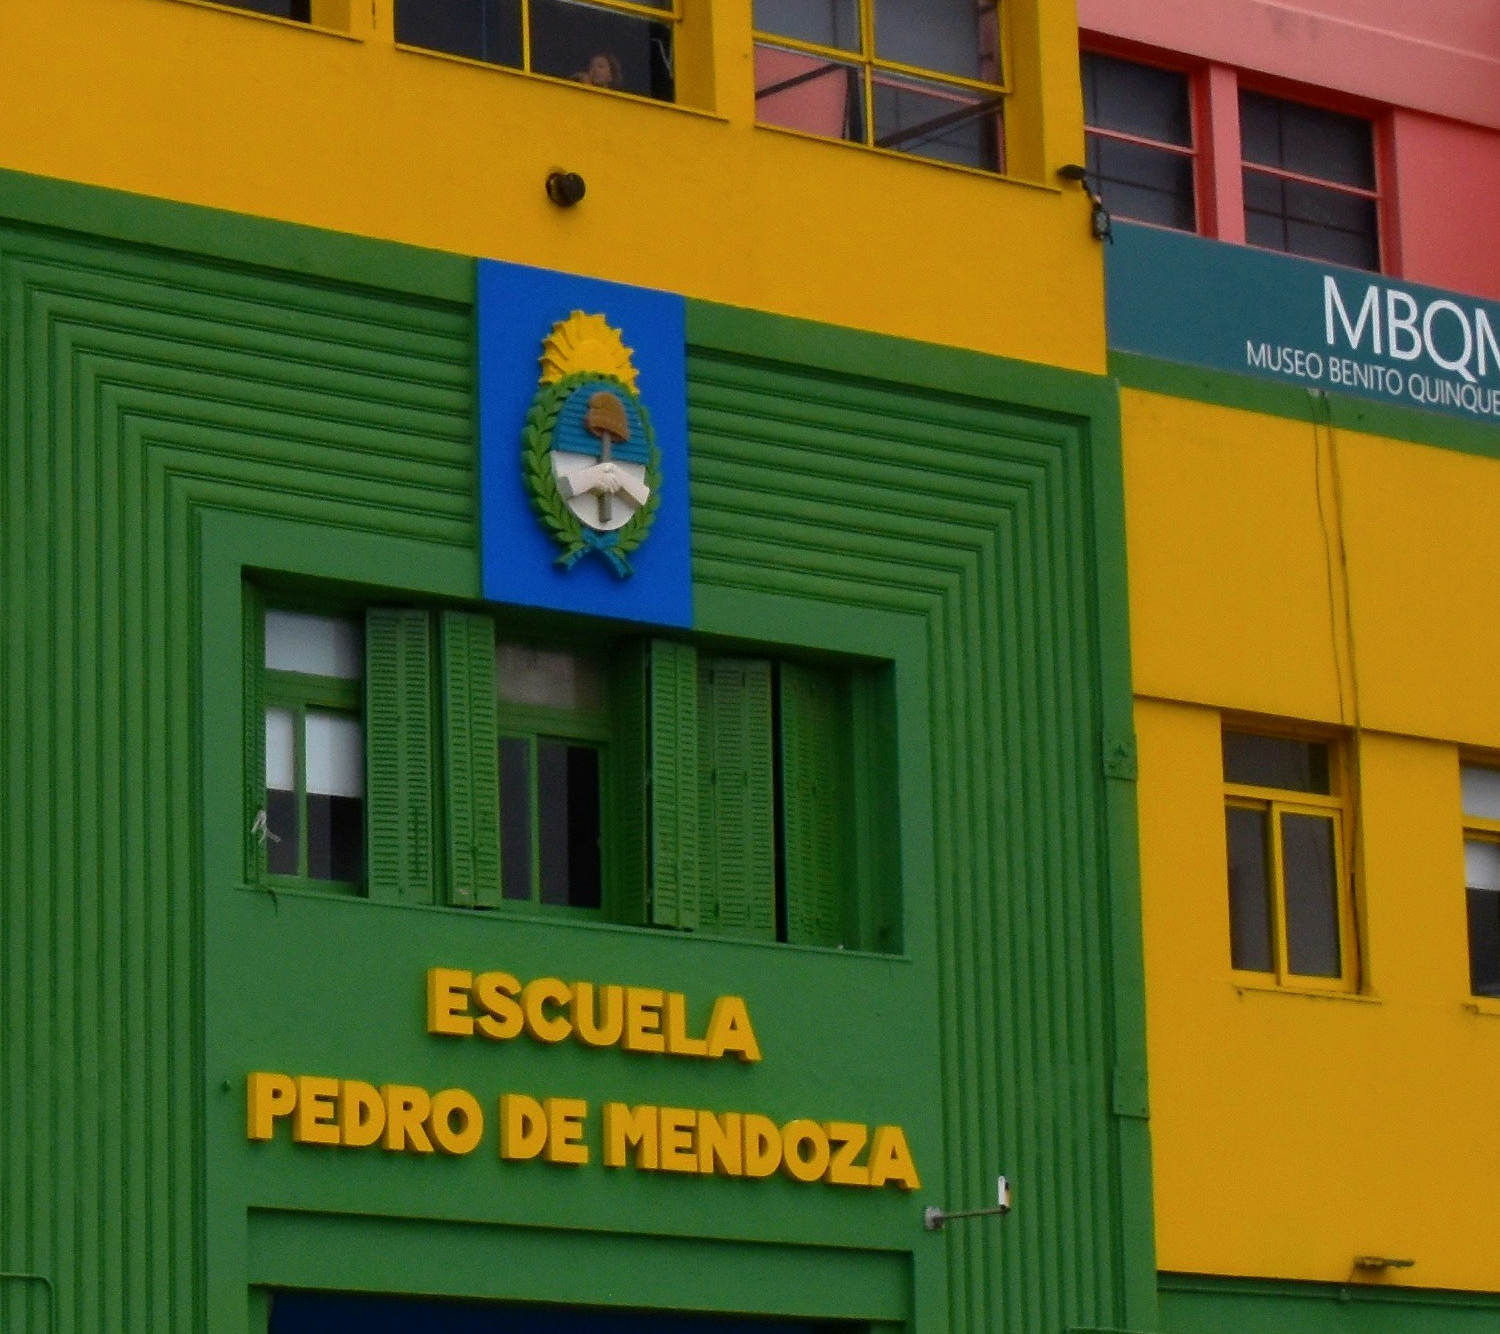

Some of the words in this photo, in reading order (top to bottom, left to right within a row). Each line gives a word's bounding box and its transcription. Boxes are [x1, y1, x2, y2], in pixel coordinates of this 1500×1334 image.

[1246, 340, 1323, 380] MUSEO
[1329, 357, 1403, 396] BENITO
[427, 968, 762, 1062] ESCUELA
[247, 1072, 484, 1156] PEDRO
[499, 1094, 590, 1165] DE
[604, 1101, 922, 1191] MENDOZA
